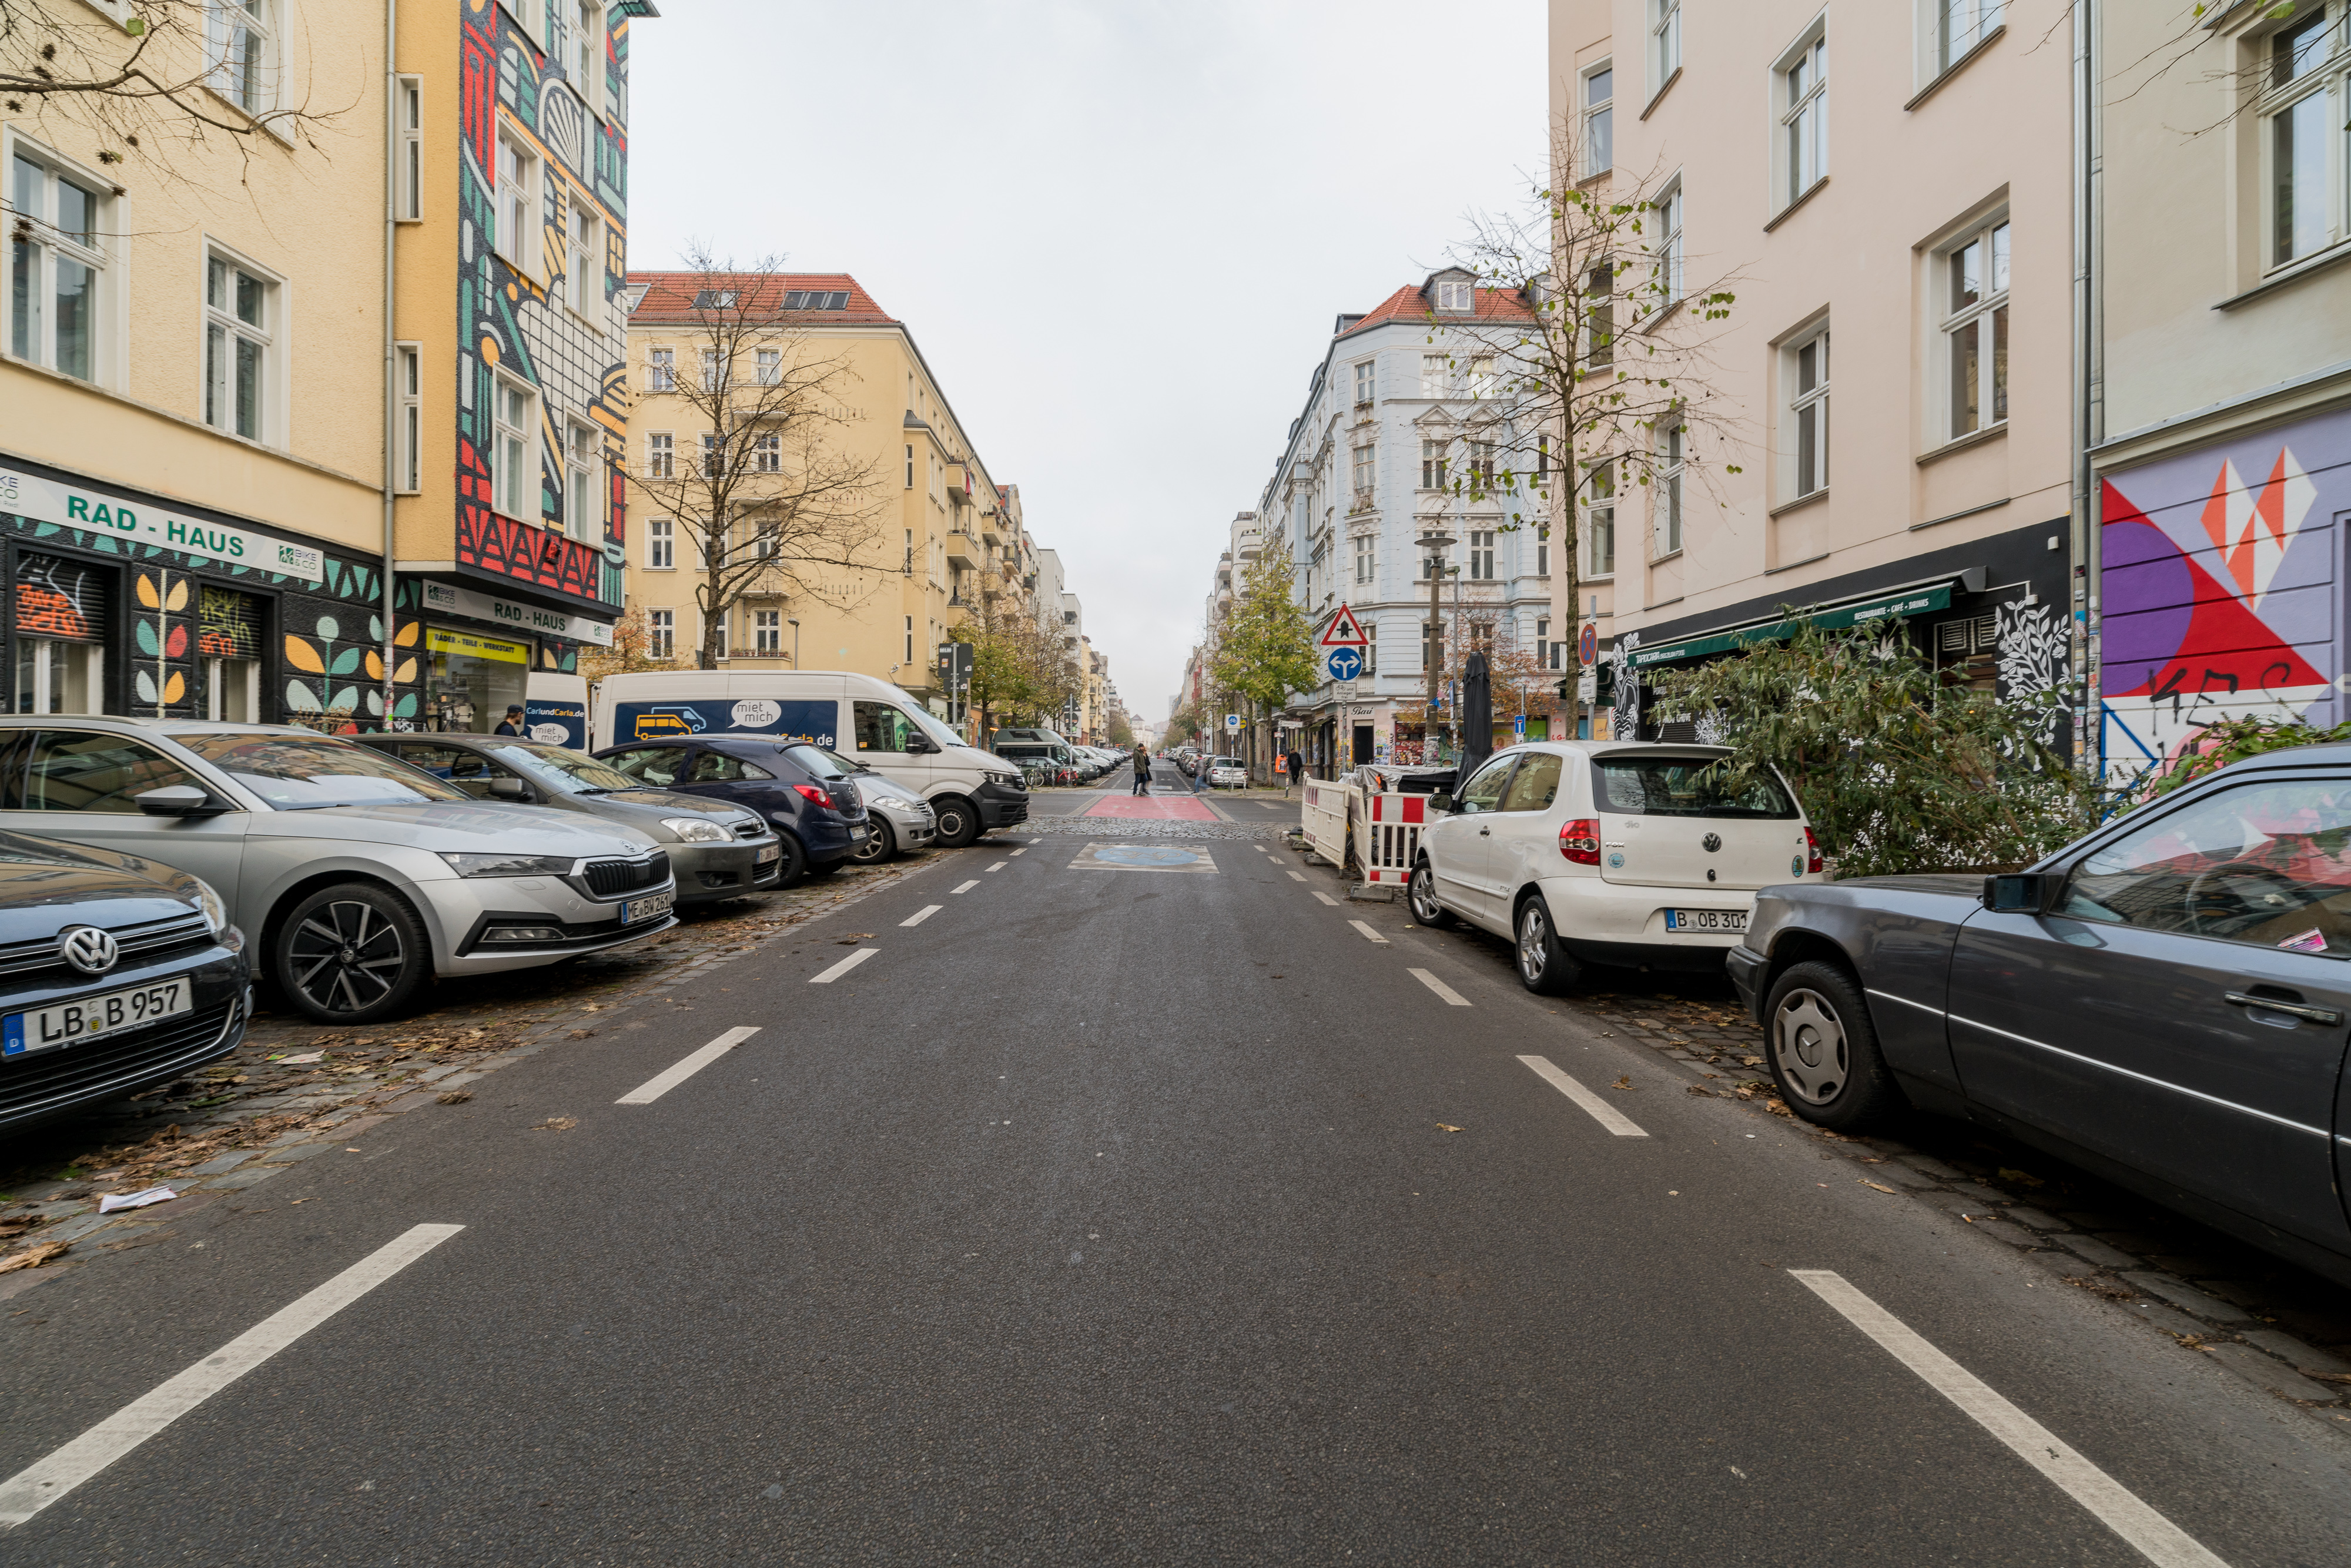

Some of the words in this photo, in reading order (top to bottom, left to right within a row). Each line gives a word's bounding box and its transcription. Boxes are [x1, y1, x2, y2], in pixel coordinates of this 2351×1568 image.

[68, 495, 137, 532] RAD
[168, 521, 245, 558] HAUS
[295, 549, 317, 561] BIKE
[302, 560, 317, 570] CO
[440, 588, 456, 598] BIKE
[444, 596, 456, 605] CO
[1854, 607, 1887, 621] RESTAURANTE
[1891, 602, 1904, 613] CAFÉ
[1908, 598, 1929, 610] DRINKS
[494, 602, 522, 621] RAD
[533, 611, 566, 632] HAUS
[434, 632, 456, 644] RÄDER
[462, 638, 478, 648] TEILE
[483, 641, 515, 654] WERKSTATT
[526, 707, 585, 718] CarlundCarla.de
[737, 702, 763, 712] miet
[745, 711, 773, 722] mich
[535, 726, 557, 735] miet
[541, 733, 563, 742] mich
[655, 894, 670, 912] 261
[1677, 912, 1687, 927] B
[1697, 912, 1718, 928] OB
[40, 1004, 84, 1043] LB
[106, 997, 125, 1027] B
[132, 982, 180, 1021] 957
[74, 1033, 111, 1045] Volkswagen
